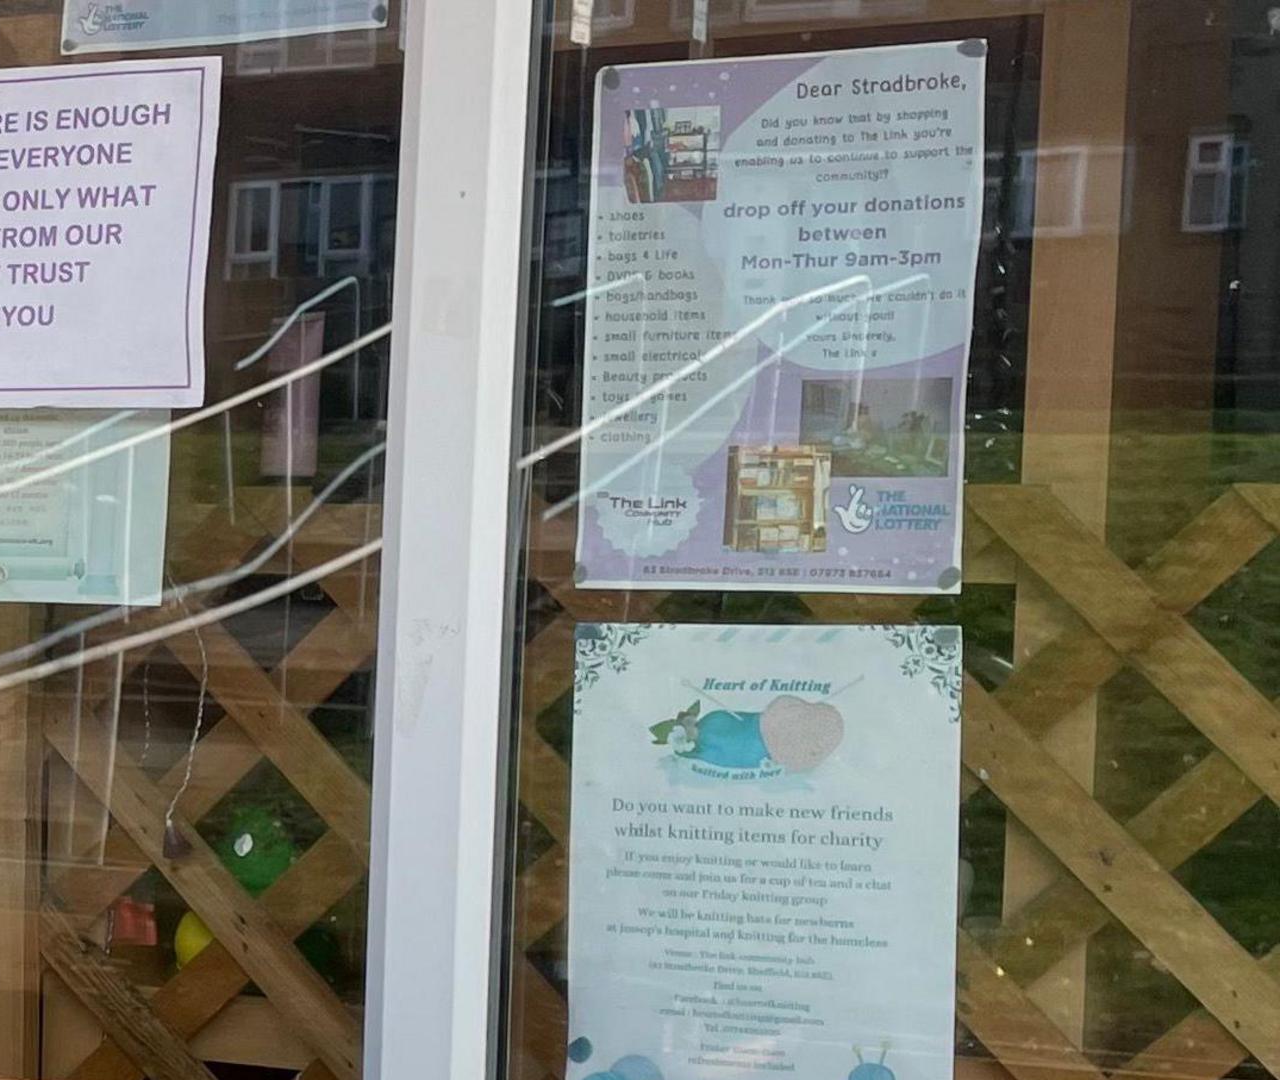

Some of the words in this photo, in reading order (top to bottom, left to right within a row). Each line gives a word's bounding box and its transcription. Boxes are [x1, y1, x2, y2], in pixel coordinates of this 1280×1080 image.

[797, 83, 842, 99] Dear
[852, 73, 966, 96] Stradbroke,
[26, 110, 49, 132] IS
[55, 103, 171, 130] ENOUGH
[761, 118, 779, 129] Did
[785, 117, 808, 129] you
[813, 114, 842, 125] know
[848, 112, 871, 124] that
[876, 111, 890, 123] by
[896, 108, 948, 122] shopping
[756, 137, 778, 147] and
[783, 134, 836, 147] donating
[842, 133, 854, 143] to
[860, 130, 878, 142] The
[883, 129, 908, 141] Link
[734, 156, 784, 167] enabling
[790, 155, 803, 165] us
[810, 154, 822, 164] to
[827, 151, 879, 163] continue
[885, 150, 897, 160] to
[903, 147, 949, 160] support
[955, 145, 972, 156] the
[2, 188, 71, 212] ONLY
[77, 185, 156, 208] WHAT
[724, 203, 770, 219] drop
[777, 201, 807, 216] off
[812, 201, 857, 217] your
[865, 195, 965, 213] donations
[65, 223, 122, 246] OUR
[609, 231, 665, 241] toiletries
[798, 226, 886, 242] between
[608, 252, 637, 263] bags
[741, 253, 838, 270] Mon-Thur
[844, 250, 941, 268] 9am-3pm
[7, 261, 90, 284] TRUST
[658, 269, 695, 280] books
[1, 305, 55, 327] YOU
[604, 331, 636, 342] small
[643, 331, 700, 341] furniture
[604, 351, 635, 361] small
[603, 371, 647, 384] Beauty
[602, 391, 630, 402] toys
[600, 432, 651, 443] clothing
[610, 497, 643, 508] The
[649, 497, 687, 508] Link
[877, 490, 906, 502] THE
[877, 503, 950, 517] NATIONAL
[875, 518, 940, 530] LOTTERY
[703, 678, 745, 691] Heart
[750, 679, 767, 691] of
[770, 679, 831, 694] Knitting
[612, 798, 634, 812] Do
[637, 802, 668, 815] you
[672, 802, 712, 816] want
[717, 804, 734, 816] to
[740, 804, 785, 818] make
[790, 808, 825, 820] new
[830, 805, 894, 822] friends
[615, 823, 662, 838] whilst
[668, 824, 734, 844] knitting
[739, 828, 786, 844] items
[791, 830, 815, 845] for
[820, 831, 883, 850] charity
